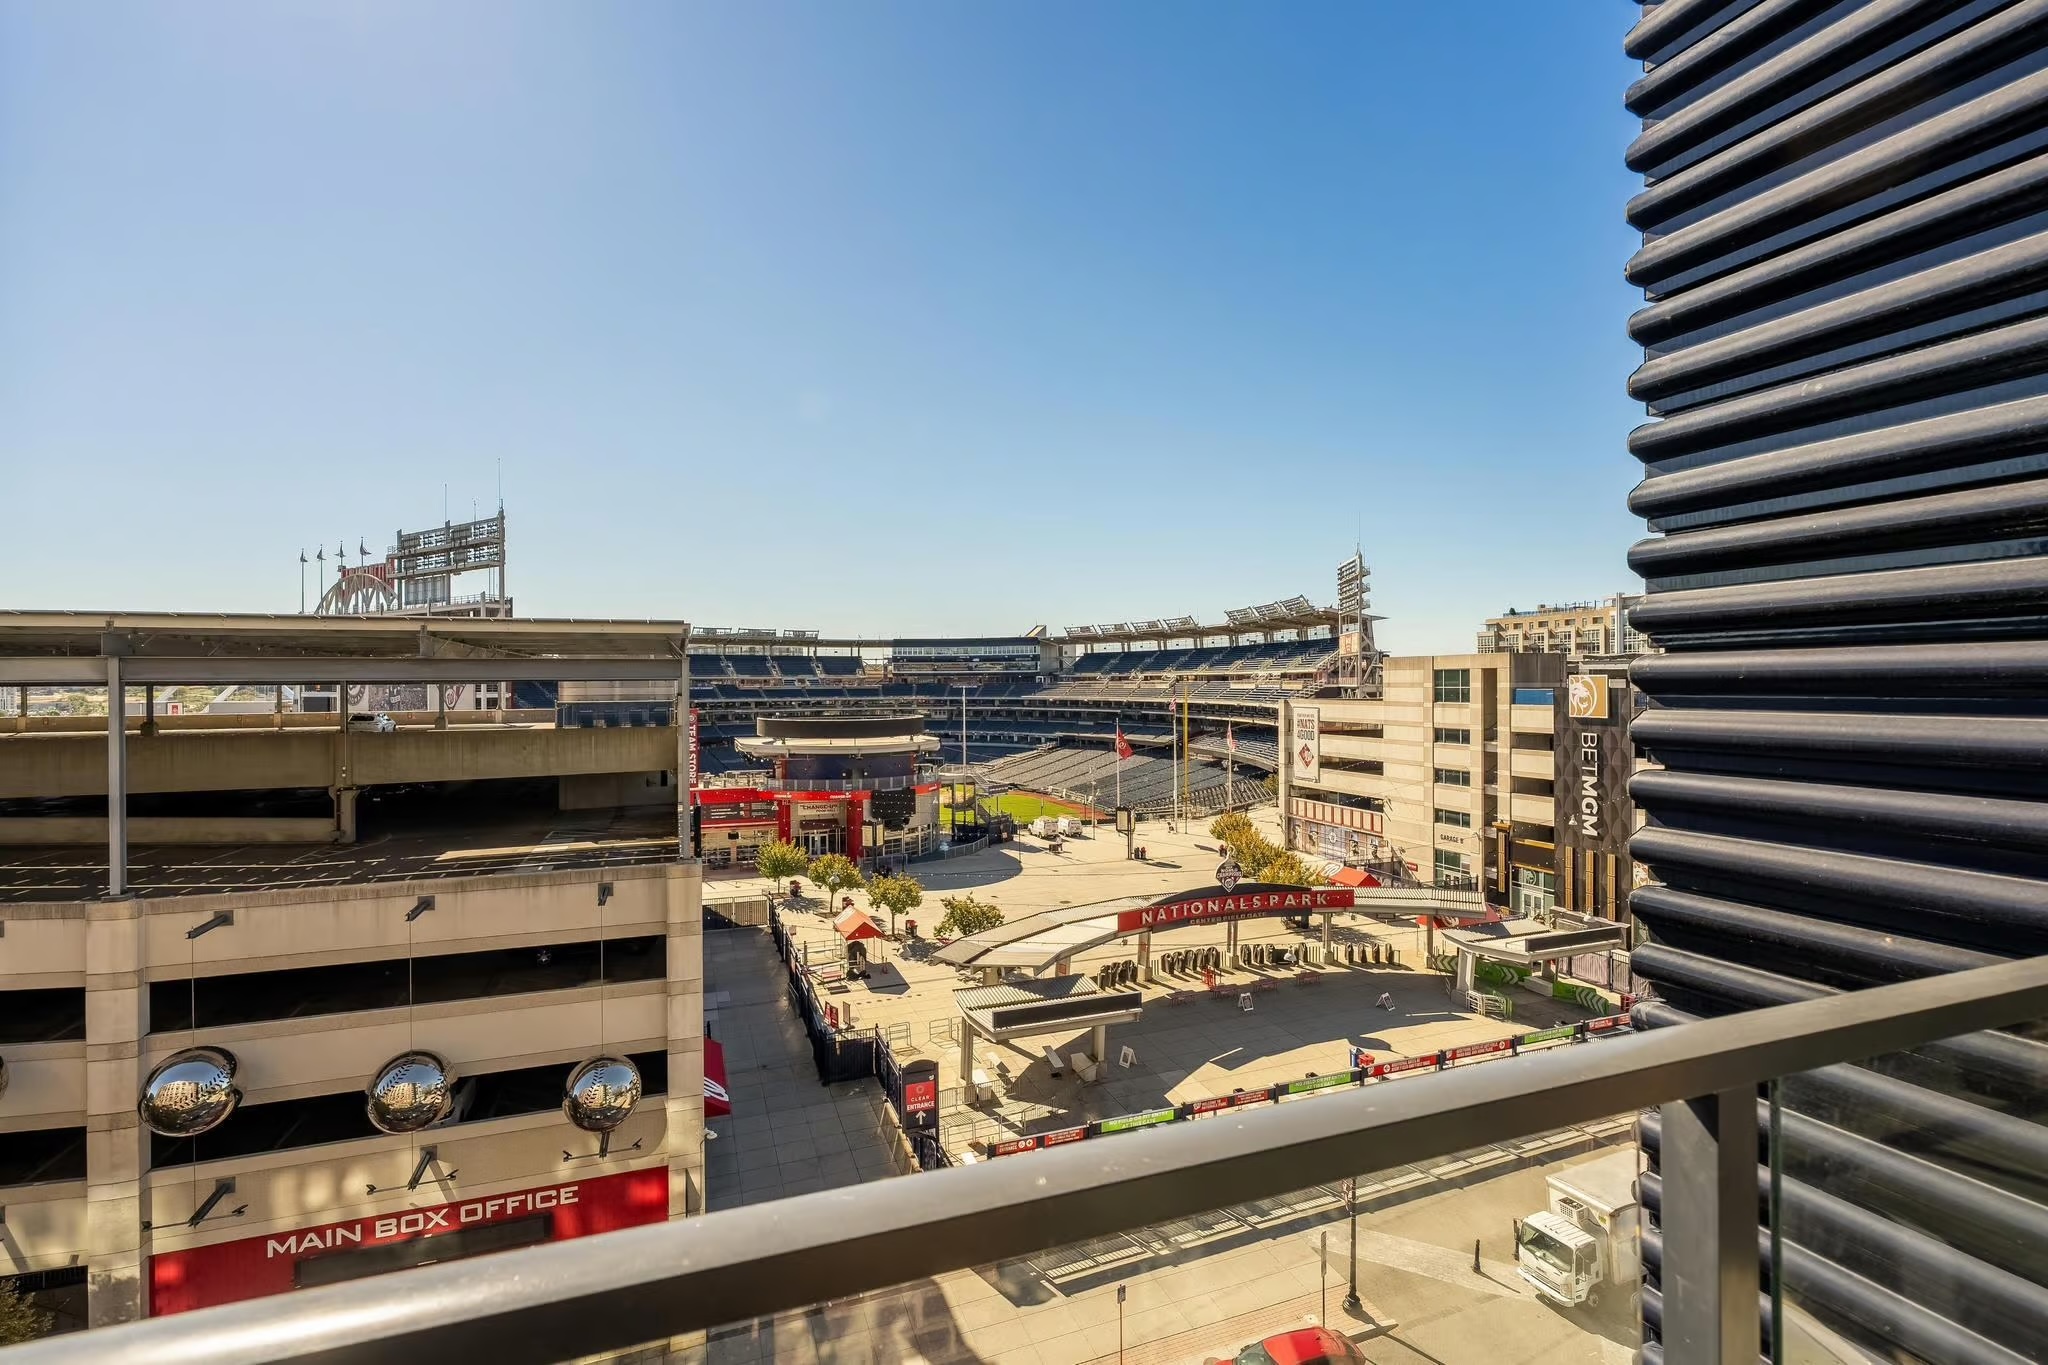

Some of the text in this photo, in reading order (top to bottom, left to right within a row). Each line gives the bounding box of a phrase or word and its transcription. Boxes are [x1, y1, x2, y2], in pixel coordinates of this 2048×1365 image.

[1297, 719, 1314, 729] #NATS
[688, 724, 696, 784] TEAM STORE
[1582, 732, 1598, 837] BETMGM
[1440, 834, 1459, 844] GARAGE
[1142, 893, 1328, 925] NATIONALS PARK
[1190, 916, 1221, 924] CENTER
[1223, 912, 1245, 921] FIELD
[907, 1101, 934, 1111] ENTRANCE
[267, 1186, 578, 1258] MAIN BOX OFFICE
